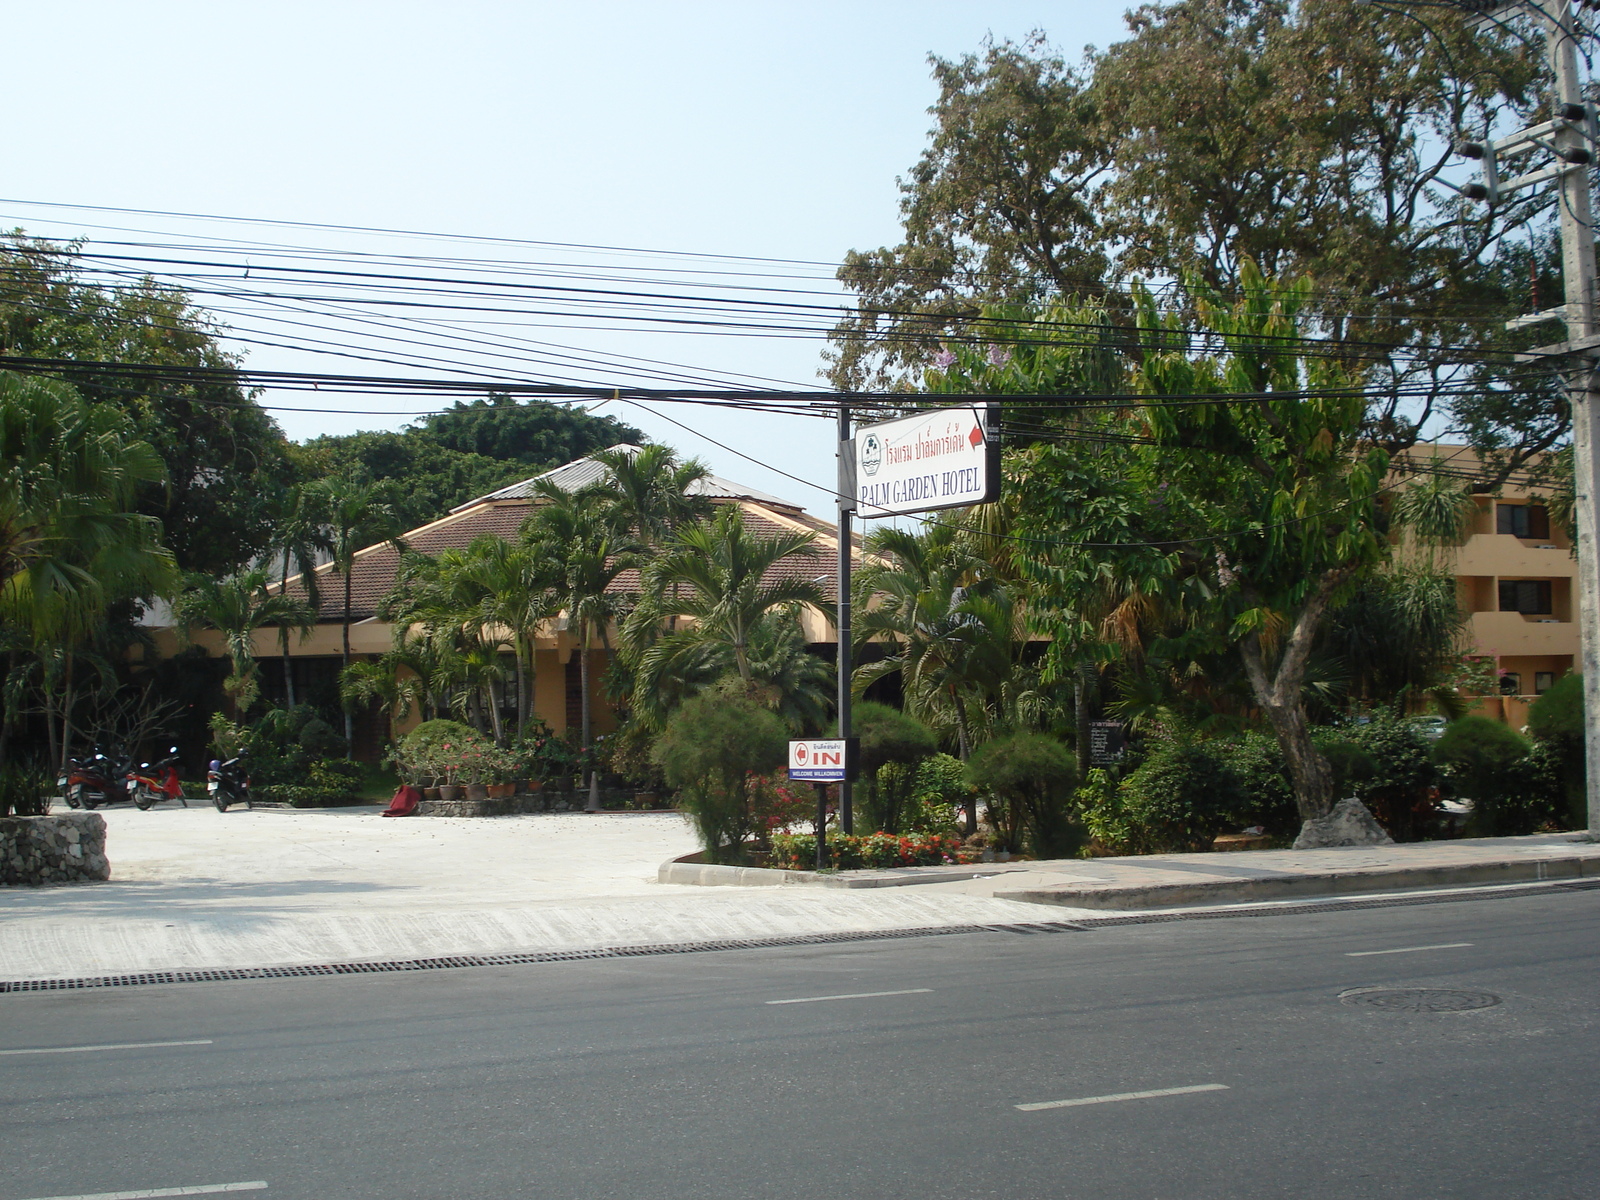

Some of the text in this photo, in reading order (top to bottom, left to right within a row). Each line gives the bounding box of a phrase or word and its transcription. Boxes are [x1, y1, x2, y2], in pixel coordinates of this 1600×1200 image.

[884, 438, 913, 466] โรงแรม
[861, 467, 981, 508] PALM GARDEN HOTEL
[813, 752, 841, 765] IN
